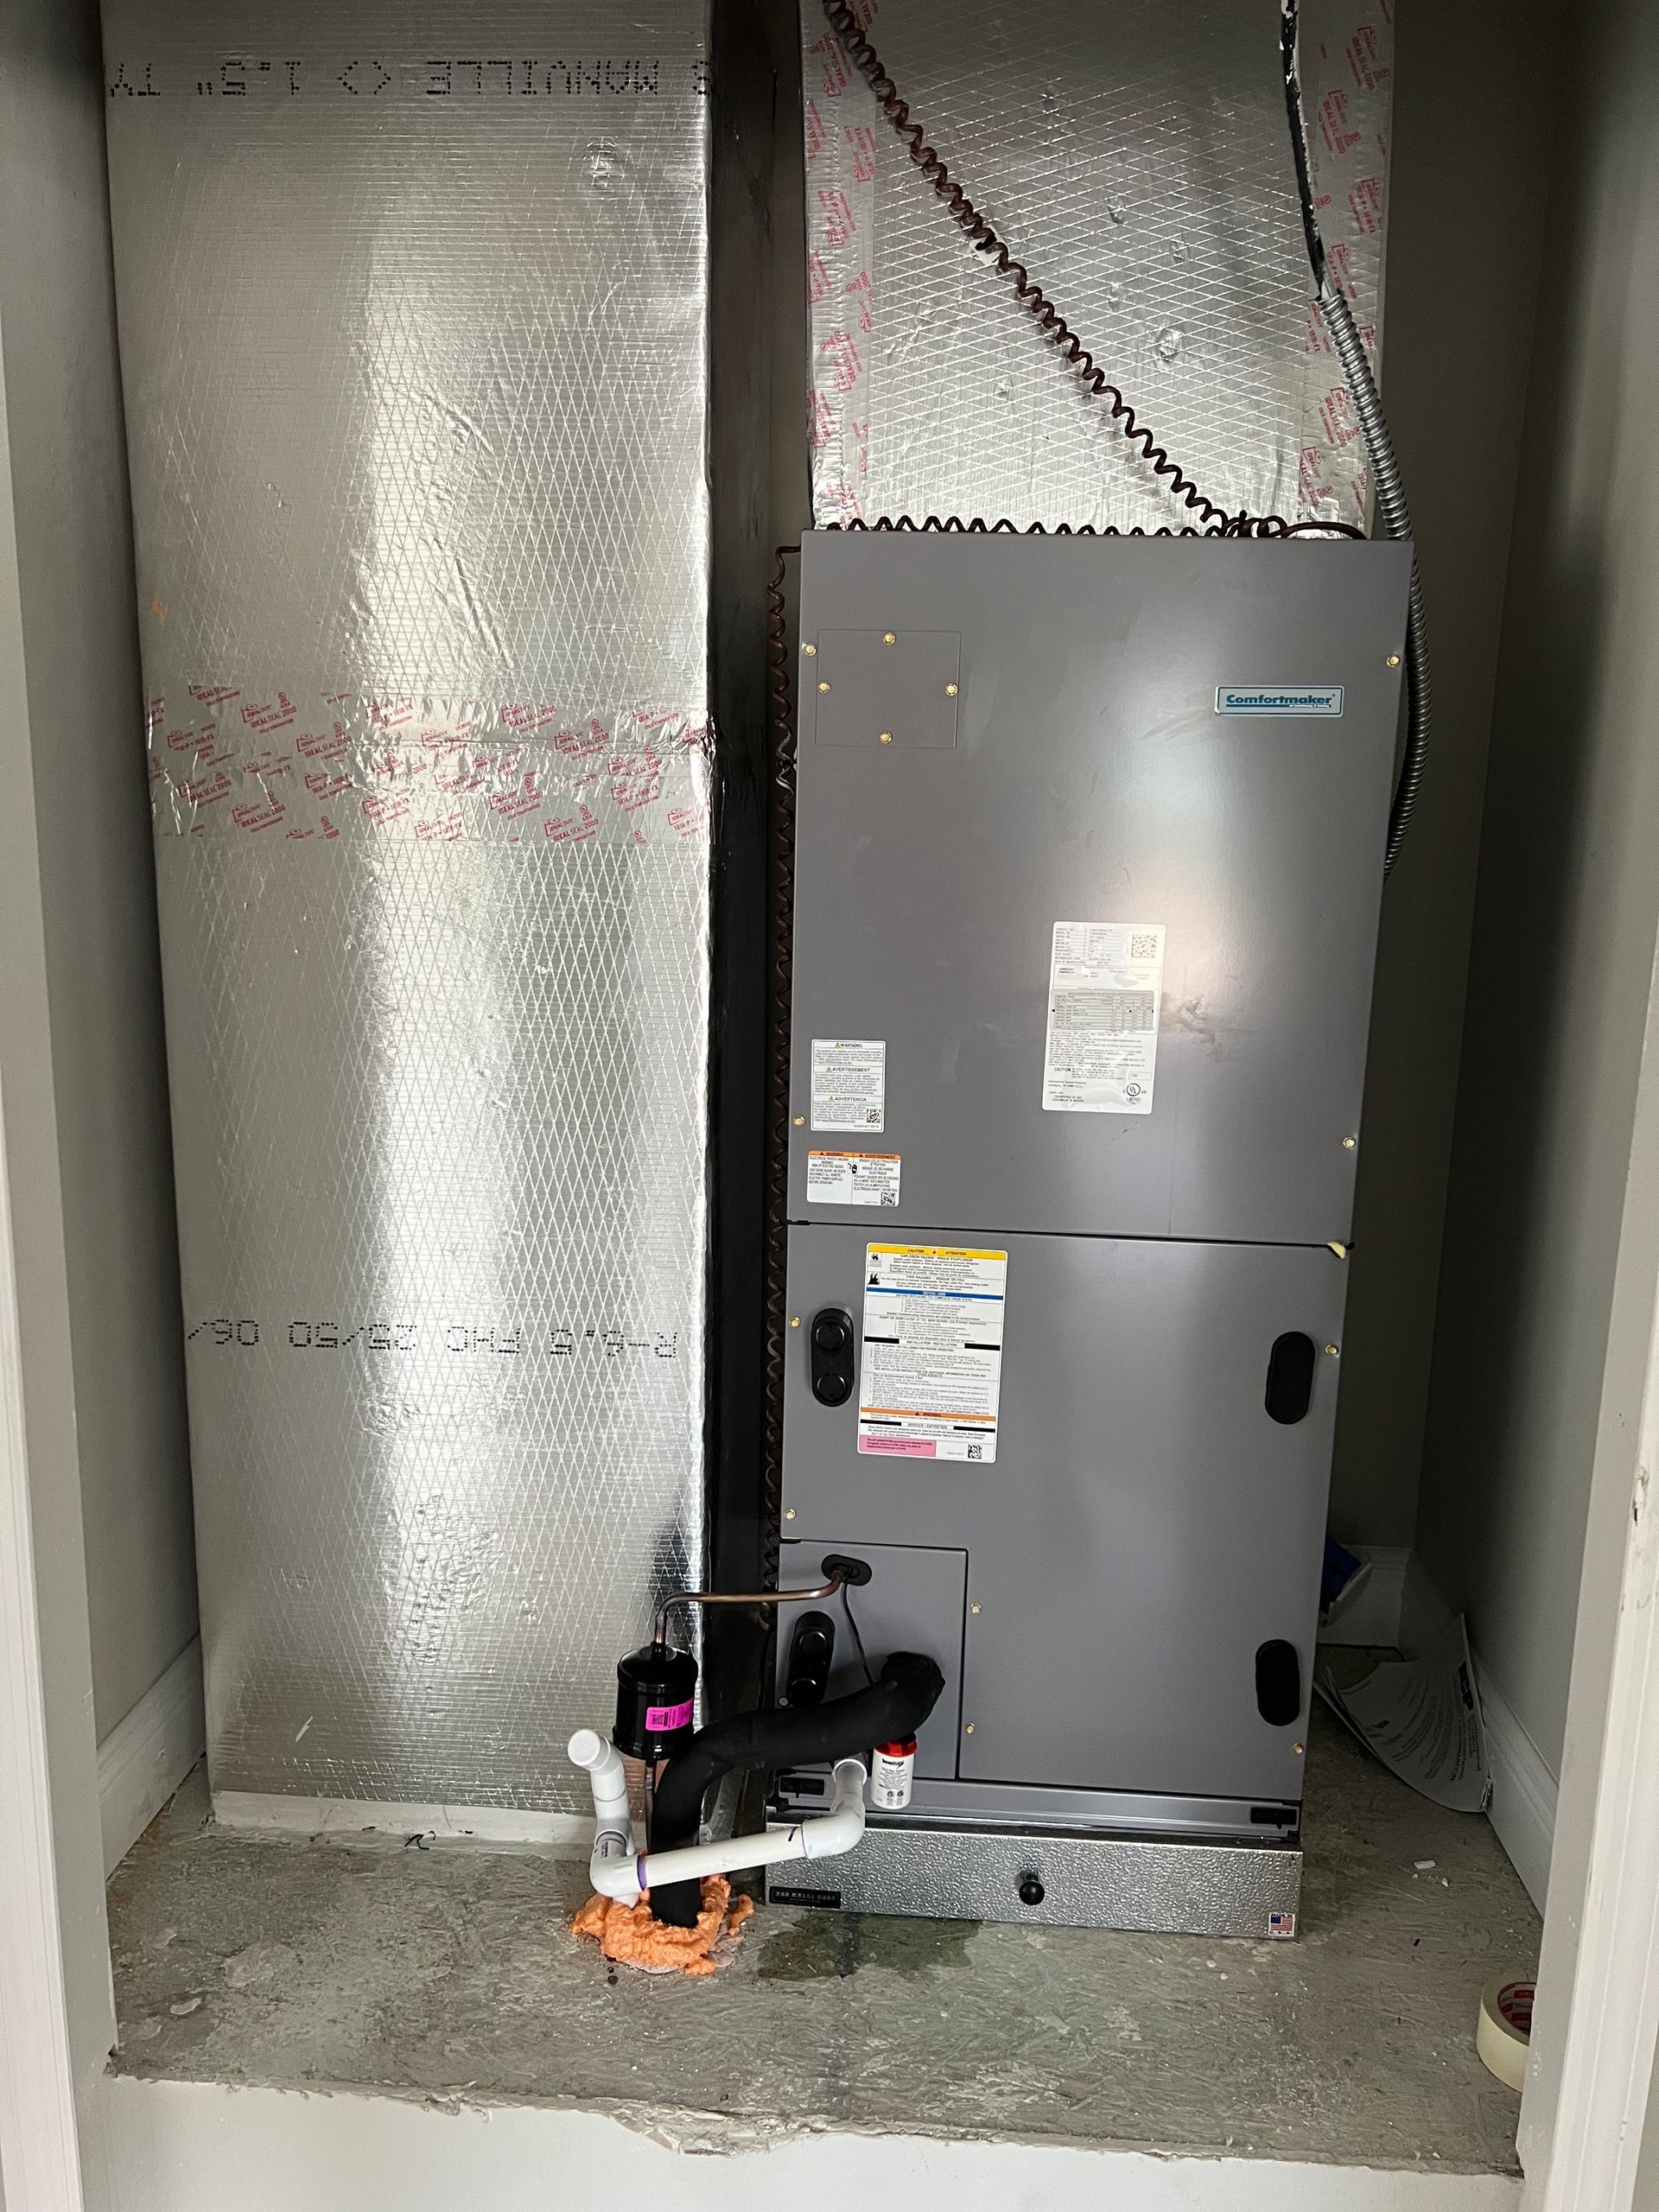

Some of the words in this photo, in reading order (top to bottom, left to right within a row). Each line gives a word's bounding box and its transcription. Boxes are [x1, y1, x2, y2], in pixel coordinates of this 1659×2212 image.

[426, 60, 659, 95] MANVILLE
[1325, 397, 1335, 416] IDEAL
[1332, 416, 1341, 431] SEAL
[1226, 694, 1332, 704] Comfortmaker
[251, 718, 268, 728] IDEAL
[268, 712, 282, 722] SEAL
[283, 706, 297, 717] 2000
[509, 717, 527, 728] IDEAL
[541, 705, 556, 716] 2000
[304, 748, 321, 758] IDEAL
[321, 742, 335, 753] SEAL
[562, 745, 580, 755] IDEAL
[594, 733, 610, 743] 2000
[633, 766, 647, 776] SEAL
[648, 760, 663, 769] 2000
[498, 804, 514, 815] IDEAL
[514, 799, 528, 809] SEAL
[529, 791, 543, 802] 2000
[241, 817, 258, 828] IDEAL
[553, 832, 570, 842] IDEAL
[570, 826, 584, 836] SEAL
[584, 818, 599, 830] 2000
[288, 1321, 416, 1351] 25/50
[550, 1330, 678, 1357] R-6.5
